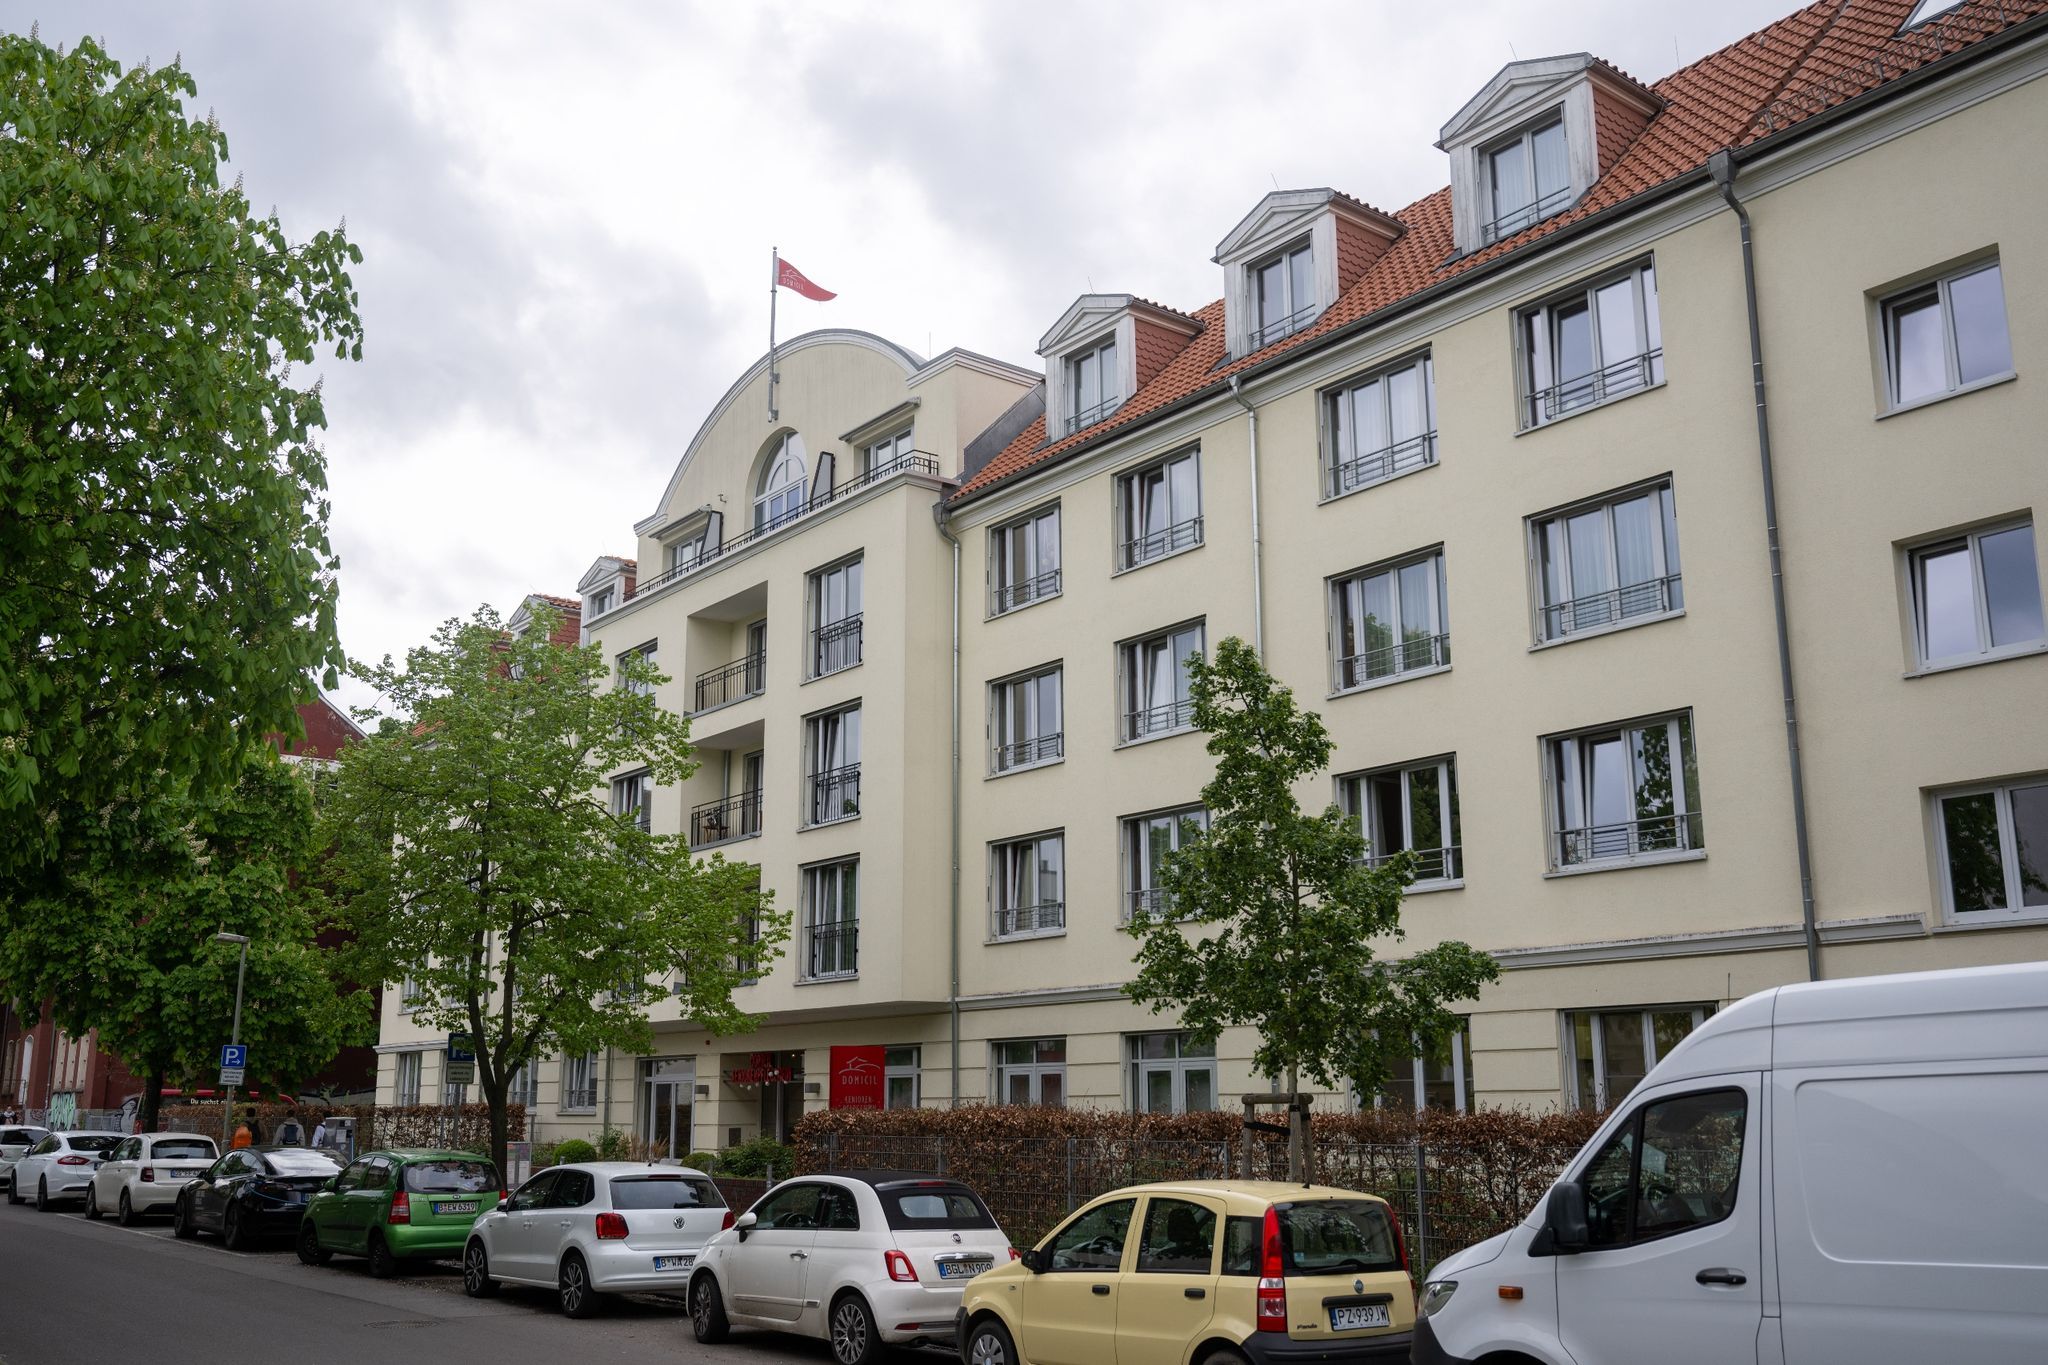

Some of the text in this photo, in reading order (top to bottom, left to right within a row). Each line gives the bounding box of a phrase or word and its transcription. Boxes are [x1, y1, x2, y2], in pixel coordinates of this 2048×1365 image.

[225, 1048, 239, 1065] P
[842, 1075, 878, 1086] DOMICIL
[661, 1258, 667, 1267] B
[683, 1257, 696, 1267] 28
[945, 1263, 964, 1275] BGL
[968, 1263, 976, 1274] N
[1337, 1309, 1355, 1324] PZ
